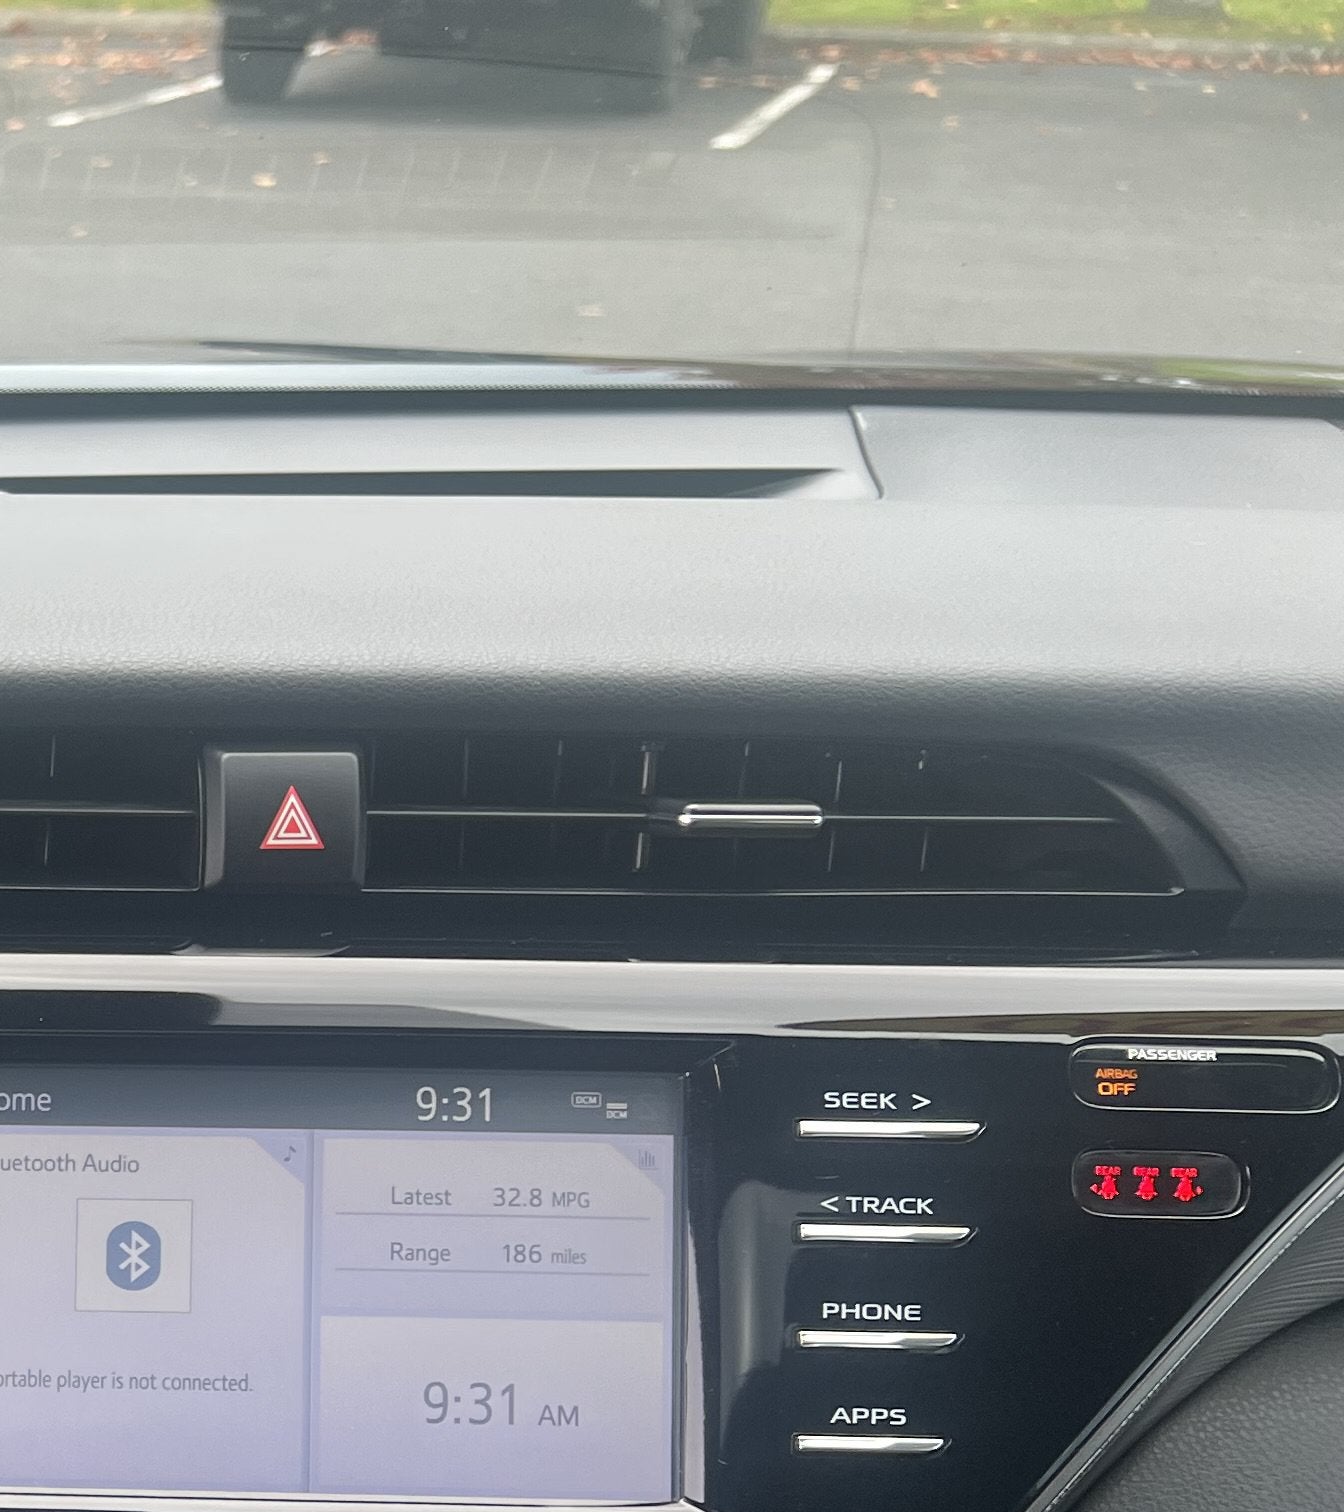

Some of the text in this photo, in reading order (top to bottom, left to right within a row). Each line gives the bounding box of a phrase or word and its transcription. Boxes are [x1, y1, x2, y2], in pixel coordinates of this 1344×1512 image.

[1128, 1049, 1218, 1061] PASSENGER
[1095, 1068, 1138, 1080] AIRBAG
[1097, 1082, 1136, 1096] OFF
[415, 1086, 493, 1123] 9:31
[823, 1091, 897, 1110] SEEK
[81, 1153, 141, 1174] Audio
[391, 1186, 590, 1208] Latest 32.8 MPG
[845, 1196, 934, 1215] TRACK
[390, 1241, 588, 1266] Range 186 miles
[822, 1302, 922, 1322] PHONE
[57, 1370, 107, 1393] player
[111, 1372, 124, 1390] is
[129, 1374, 157, 1391] not
[162, 1373, 254, 1393] connected.
[423, 1381, 580, 1427] 9:31 AM
[830, 1406, 907, 1426] APPS
